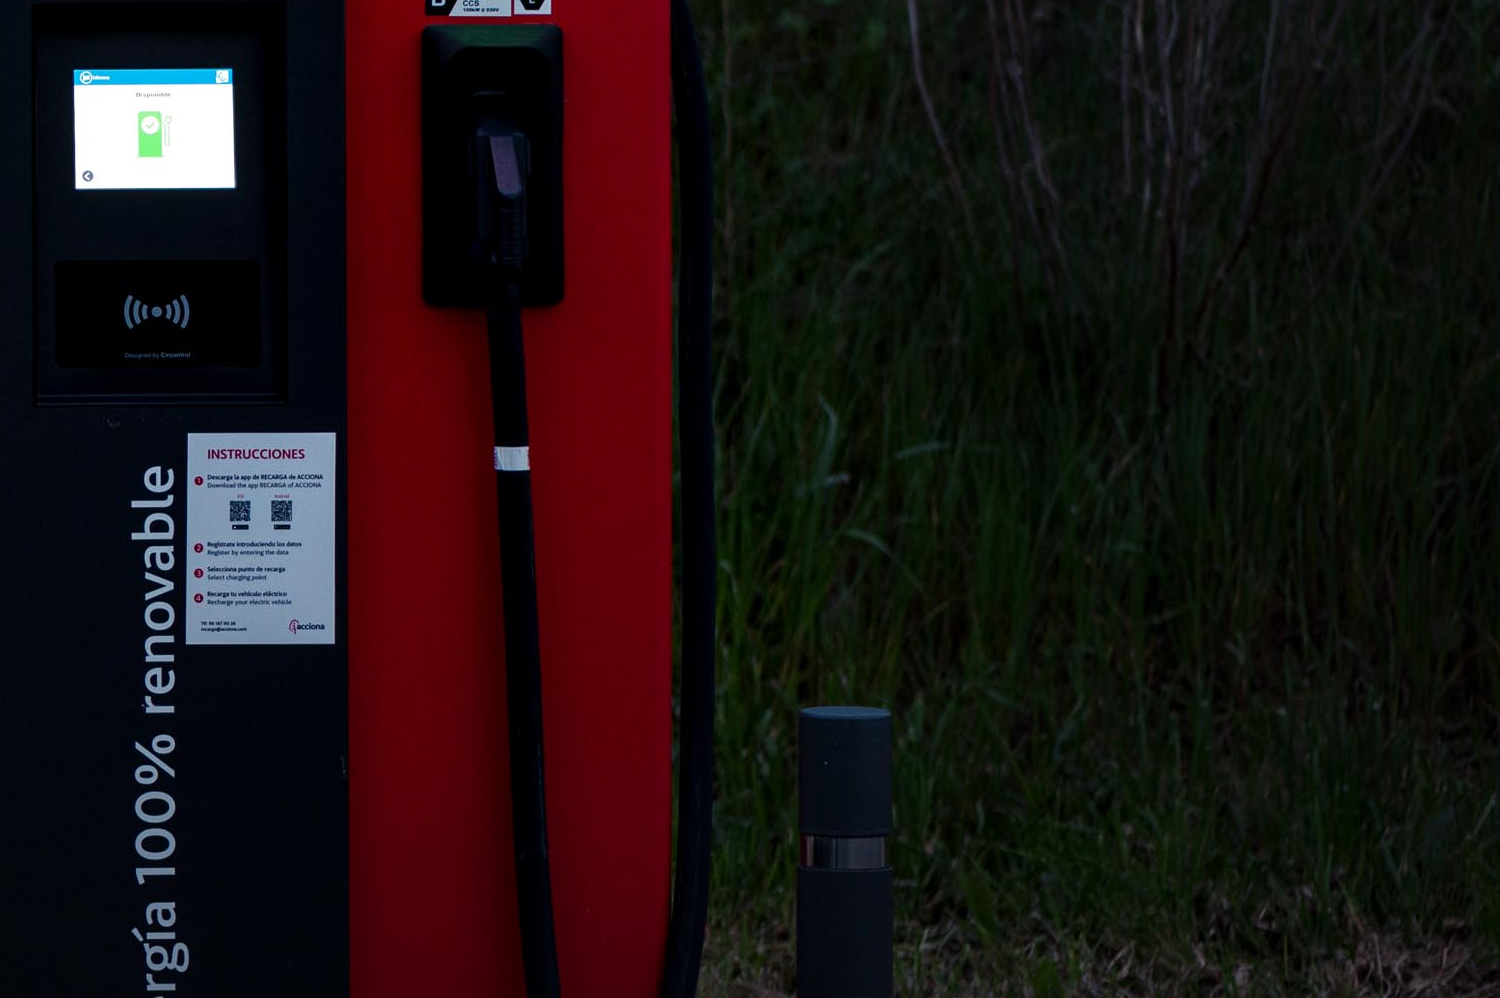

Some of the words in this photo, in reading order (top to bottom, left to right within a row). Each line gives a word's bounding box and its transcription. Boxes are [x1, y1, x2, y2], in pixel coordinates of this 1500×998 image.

[207, 449, 306, 460] INSTRUCCIONES
[131, 465, 176, 714] renovable
[297, 622, 325, 630] acciona
[134, 734, 177, 885] 100%
[131, 902, 190, 998] rgía
